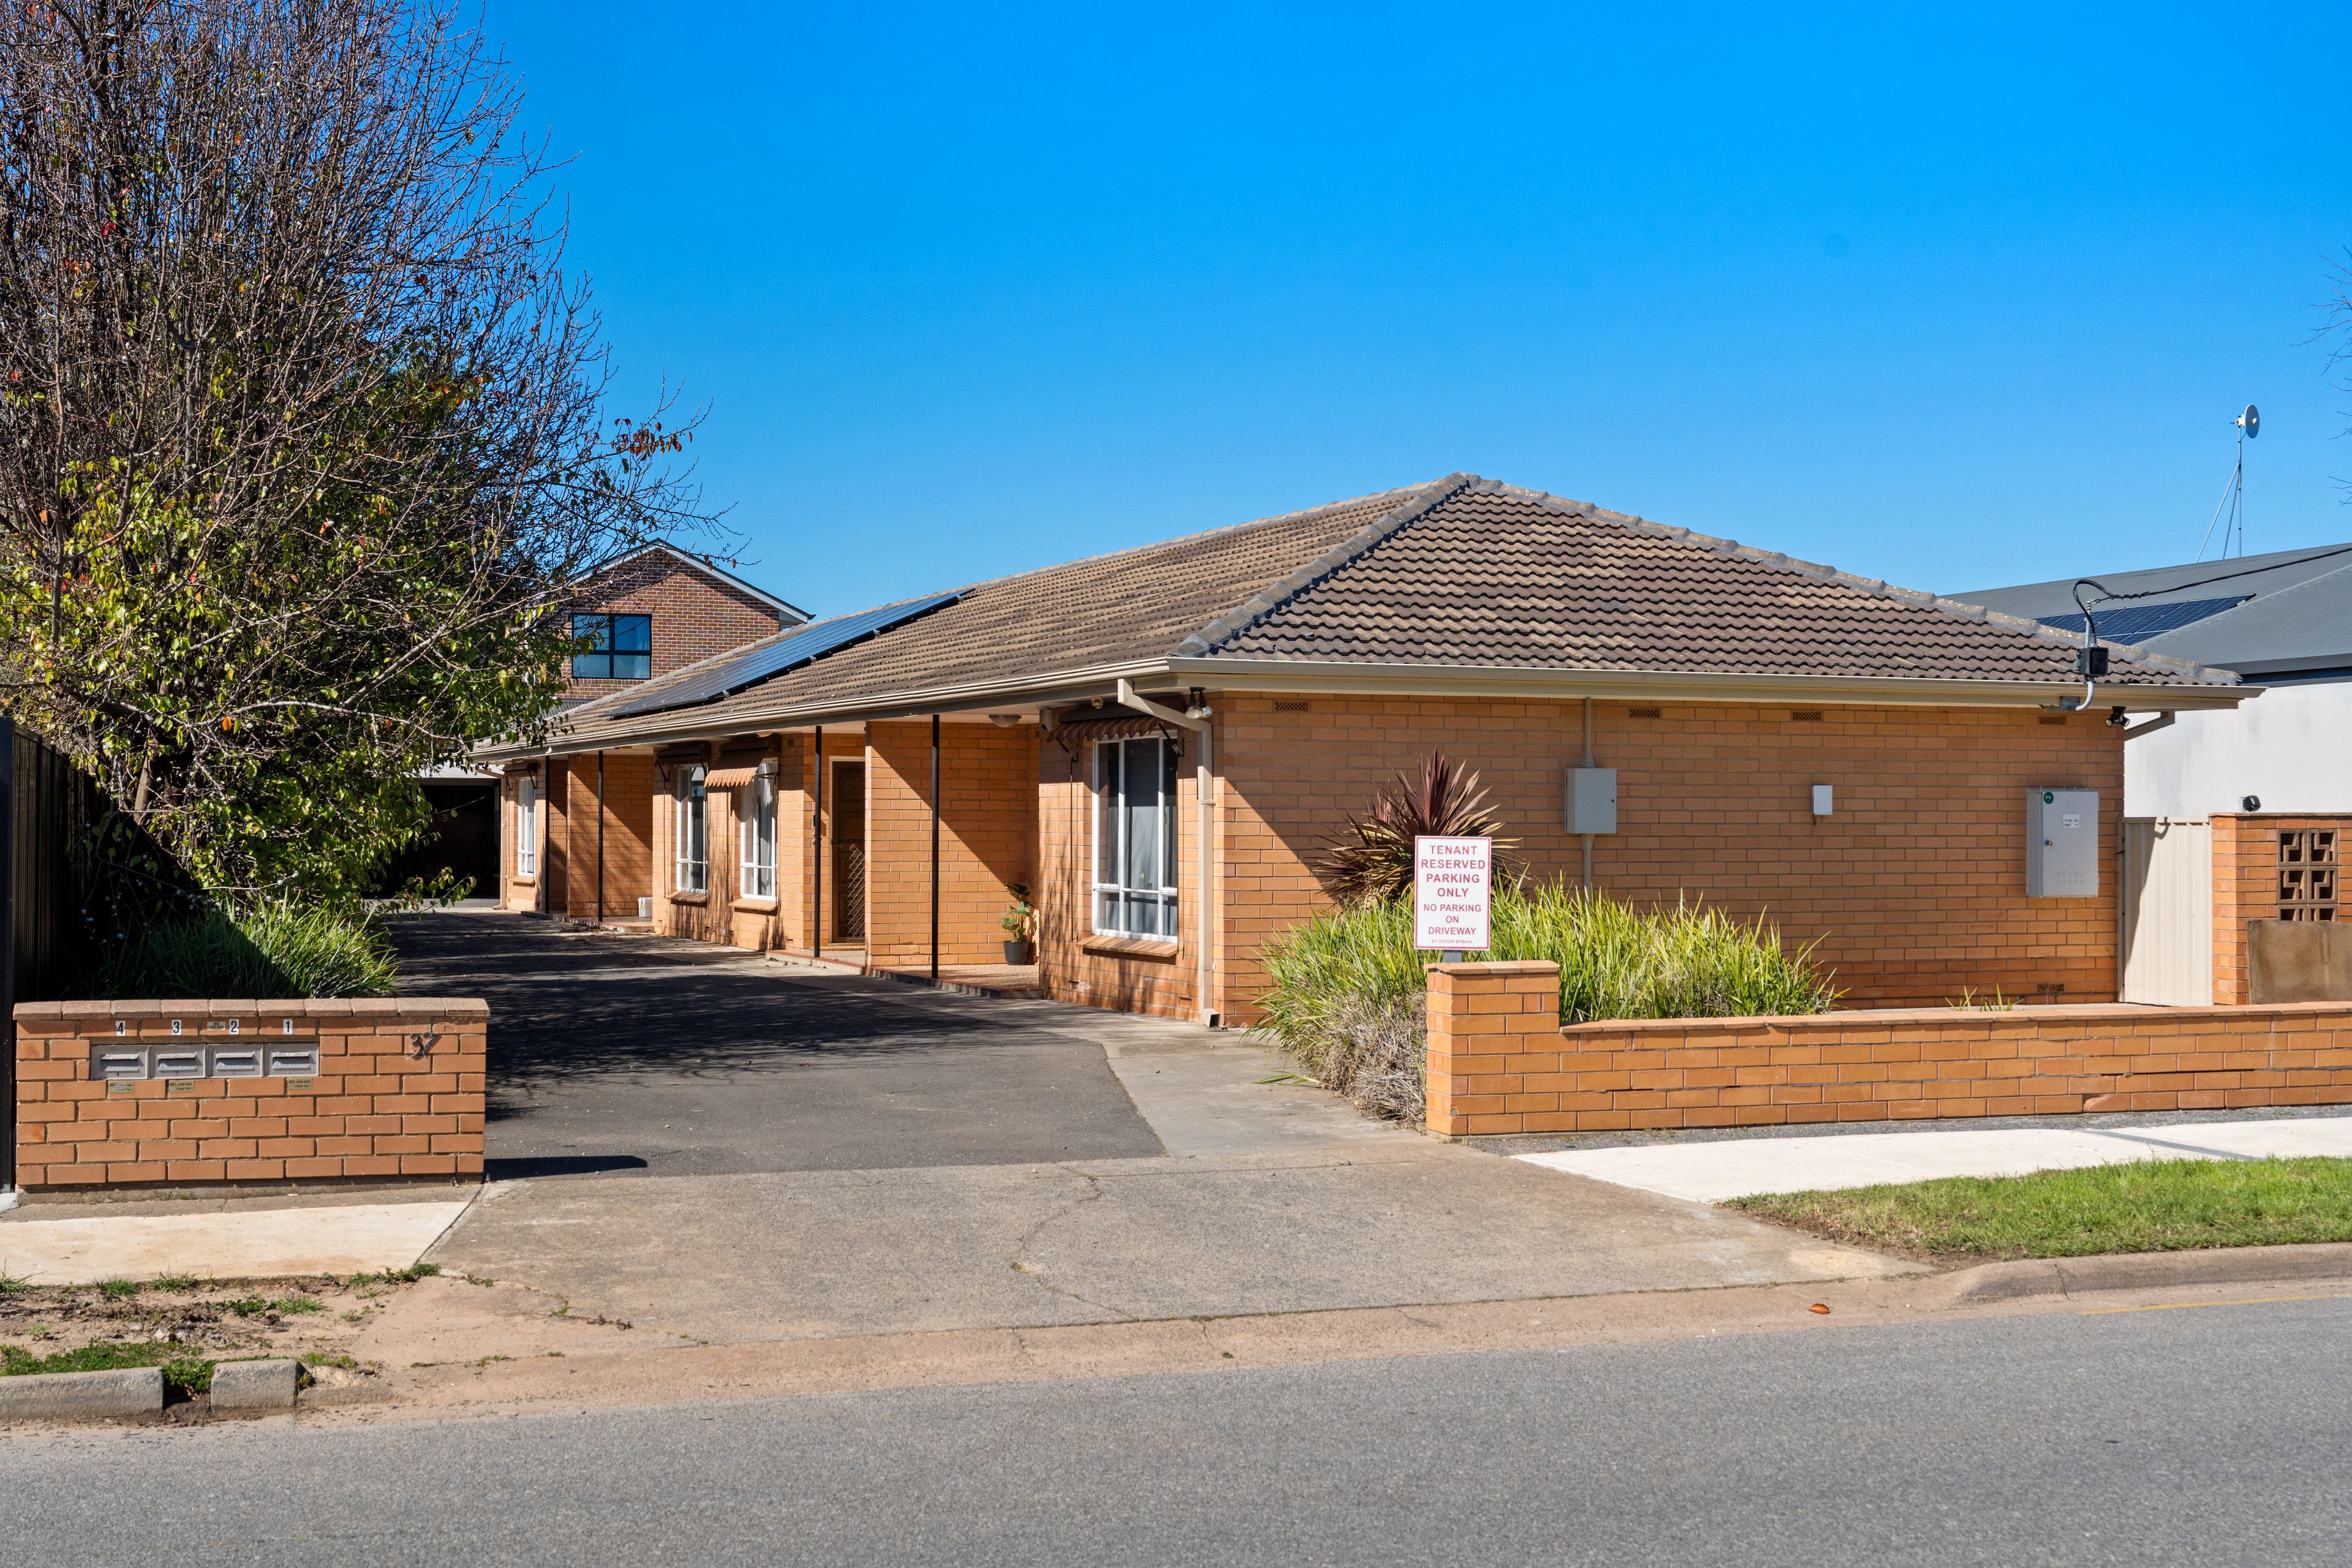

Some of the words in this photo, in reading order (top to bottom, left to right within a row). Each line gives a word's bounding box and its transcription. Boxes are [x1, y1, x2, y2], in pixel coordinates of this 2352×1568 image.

[1430, 845, 1477, 855] TENANT
[1421, 859, 1485, 869] RESERVED
[1427, 873, 1480, 883] PARKING
[1438, 888, 1468, 897] ONLY
[1428, 927, 1476, 935] DRIVEWAY
[117, 1022, 124, 1034] 4
[173, 1021, 179, 1033] 3
[231, 1020, 237, 1033] 2
[285, 1020, 290, 1033] 1
[410, 1033, 442, 1057] 37
